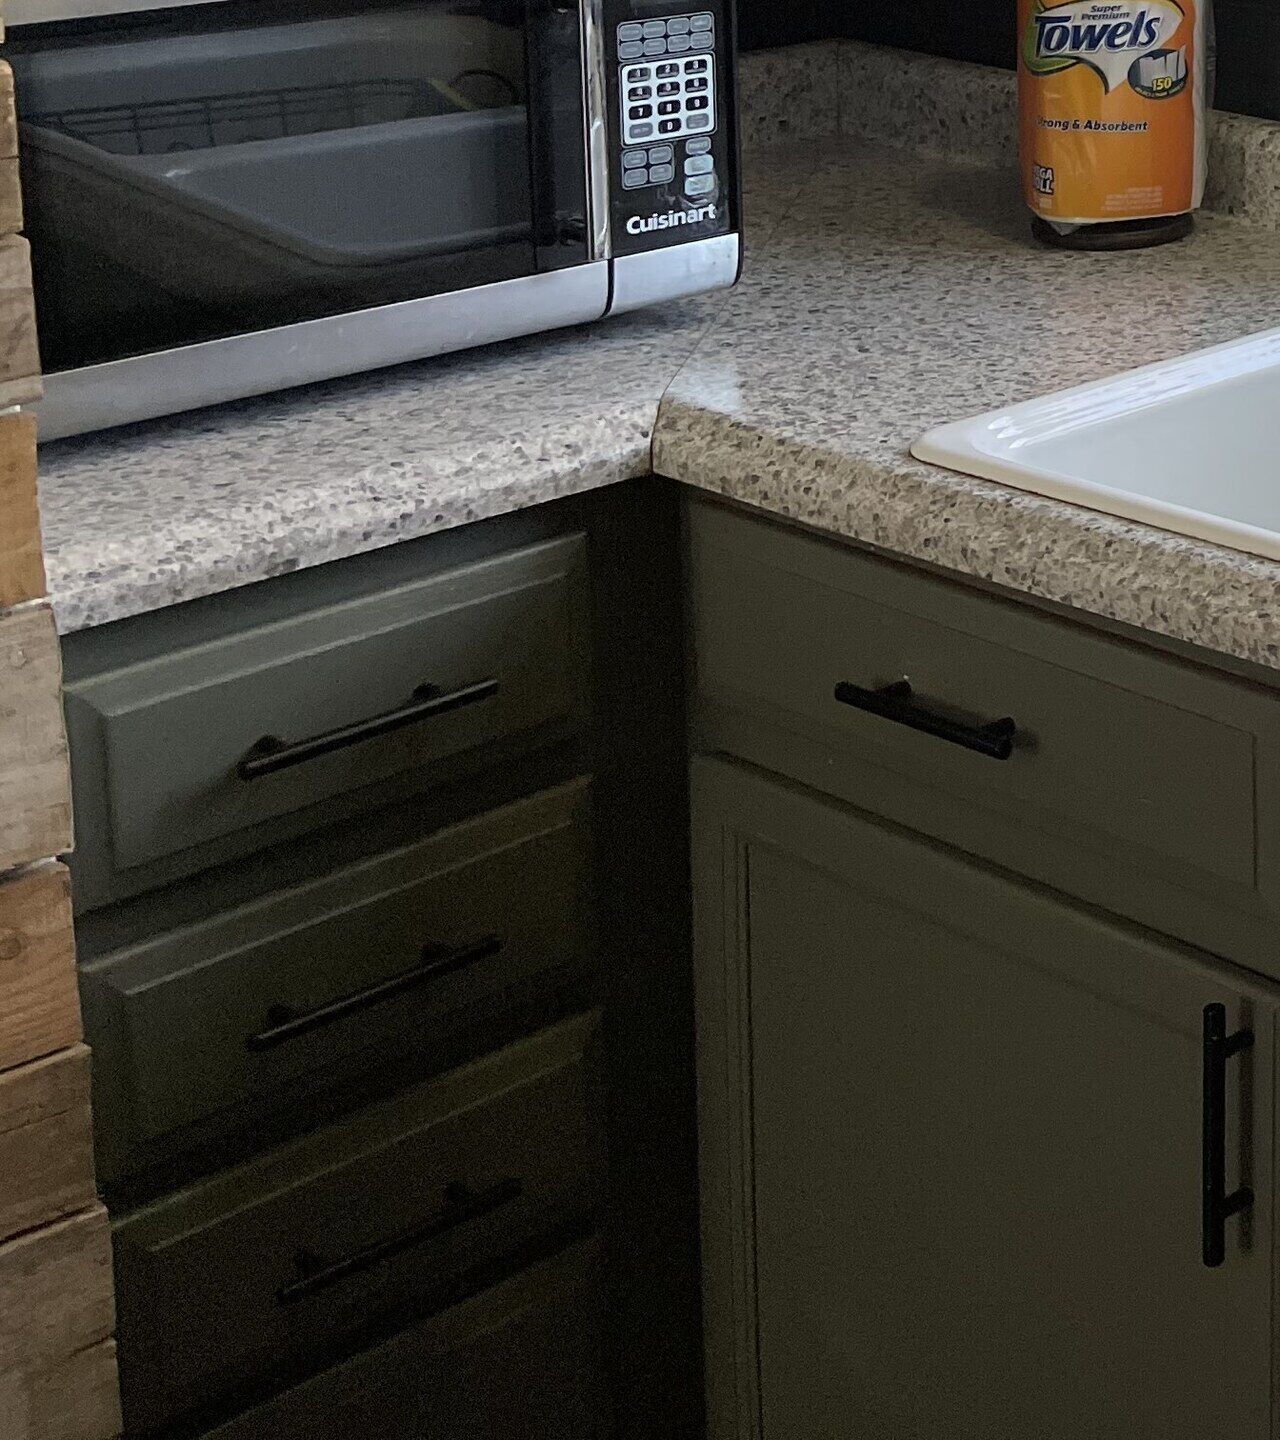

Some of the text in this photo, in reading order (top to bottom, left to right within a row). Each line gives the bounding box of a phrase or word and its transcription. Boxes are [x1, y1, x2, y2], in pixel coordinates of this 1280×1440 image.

[1090, 4, 1123, 13] Super
[1081, 11, 1129, 21] Premium
[1035, 10, 1160, 58] Towels
[1152, 77, 1172, 91] 150
[1072, 119, 1080, 129] &
[1084, 120, 1148, 132] Absorbent
[1034, 178, 1053, 193] OLL
[626, 203, 716, 235] Cuisinart
